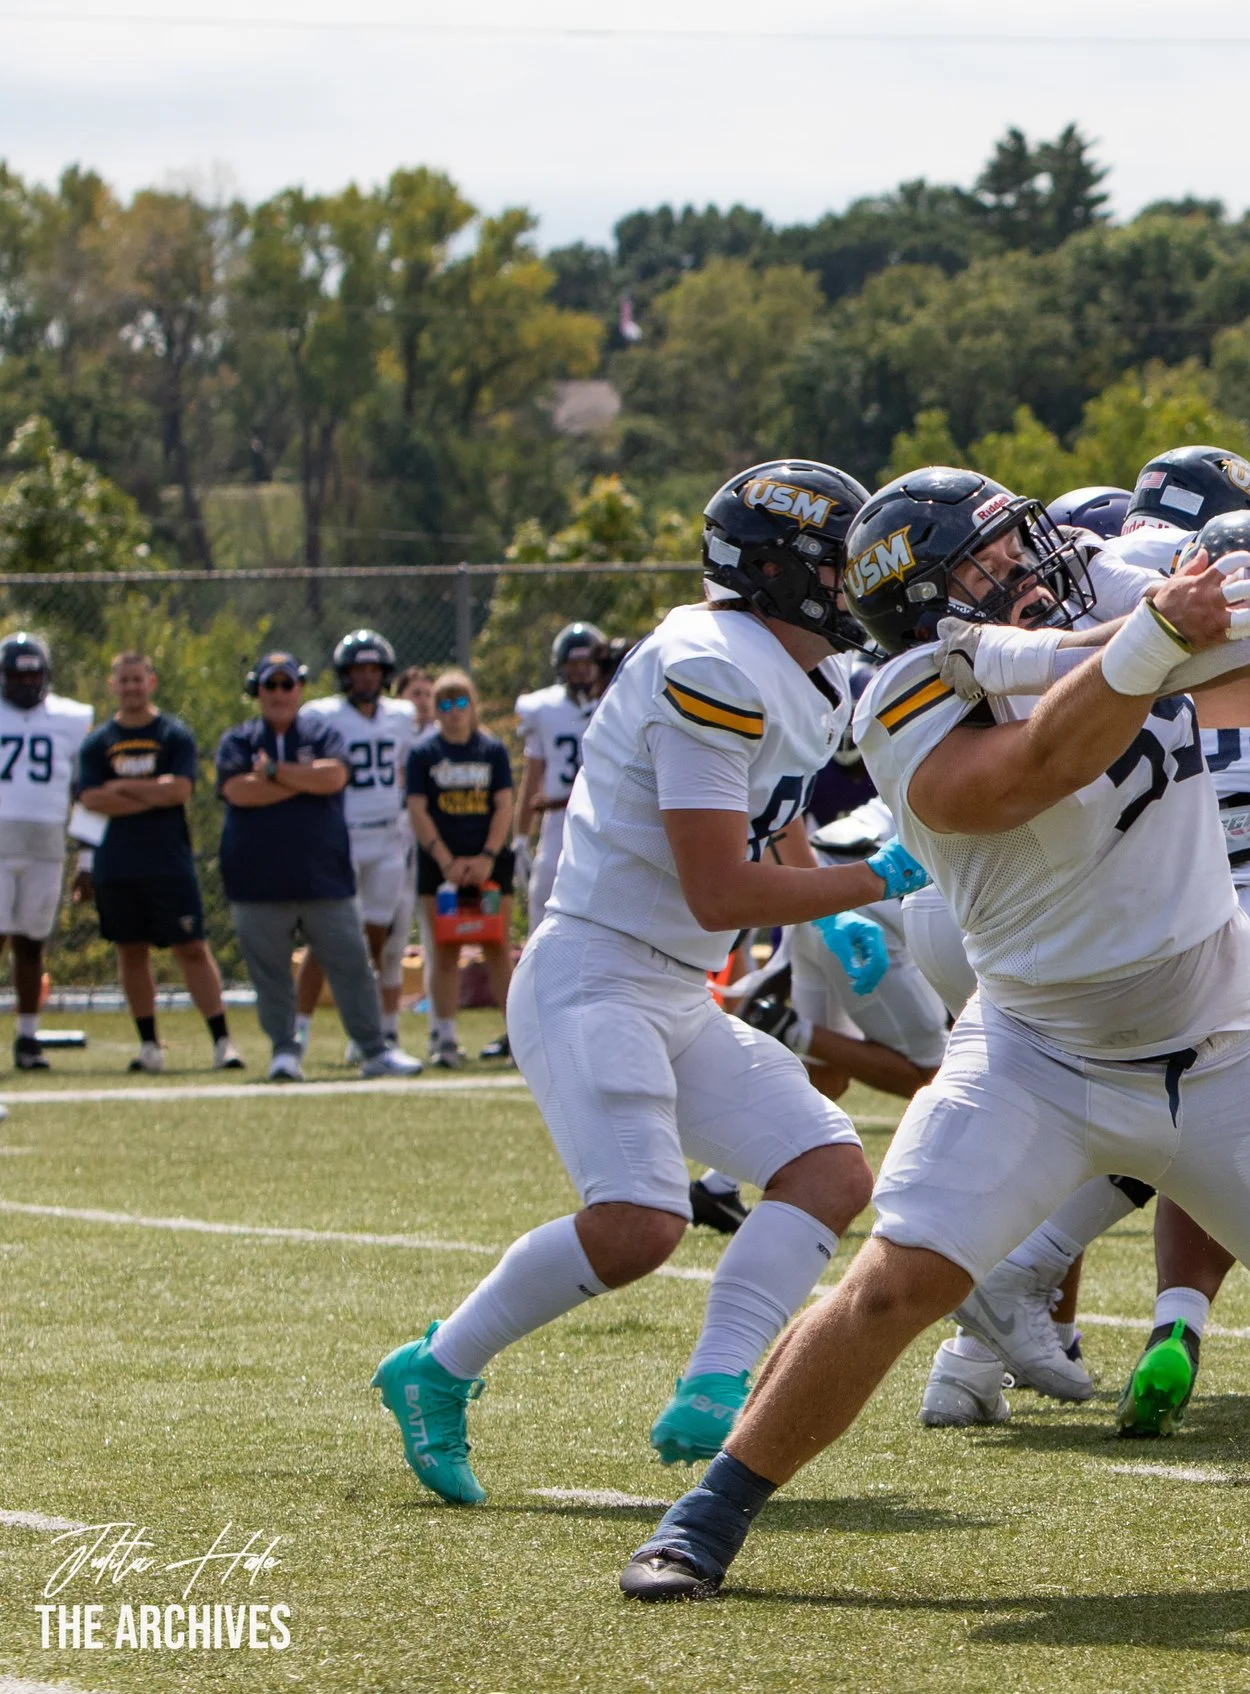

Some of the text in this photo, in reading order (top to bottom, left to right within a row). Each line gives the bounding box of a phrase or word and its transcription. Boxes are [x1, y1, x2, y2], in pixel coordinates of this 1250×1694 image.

[744, 478, 839, 528] USM
[843, 524, 917, 598] USM
[0, 735, 53, 783] 79
[350, 740, 396, 787] 25
[404, 1384, 438, 1471] BATTLE
